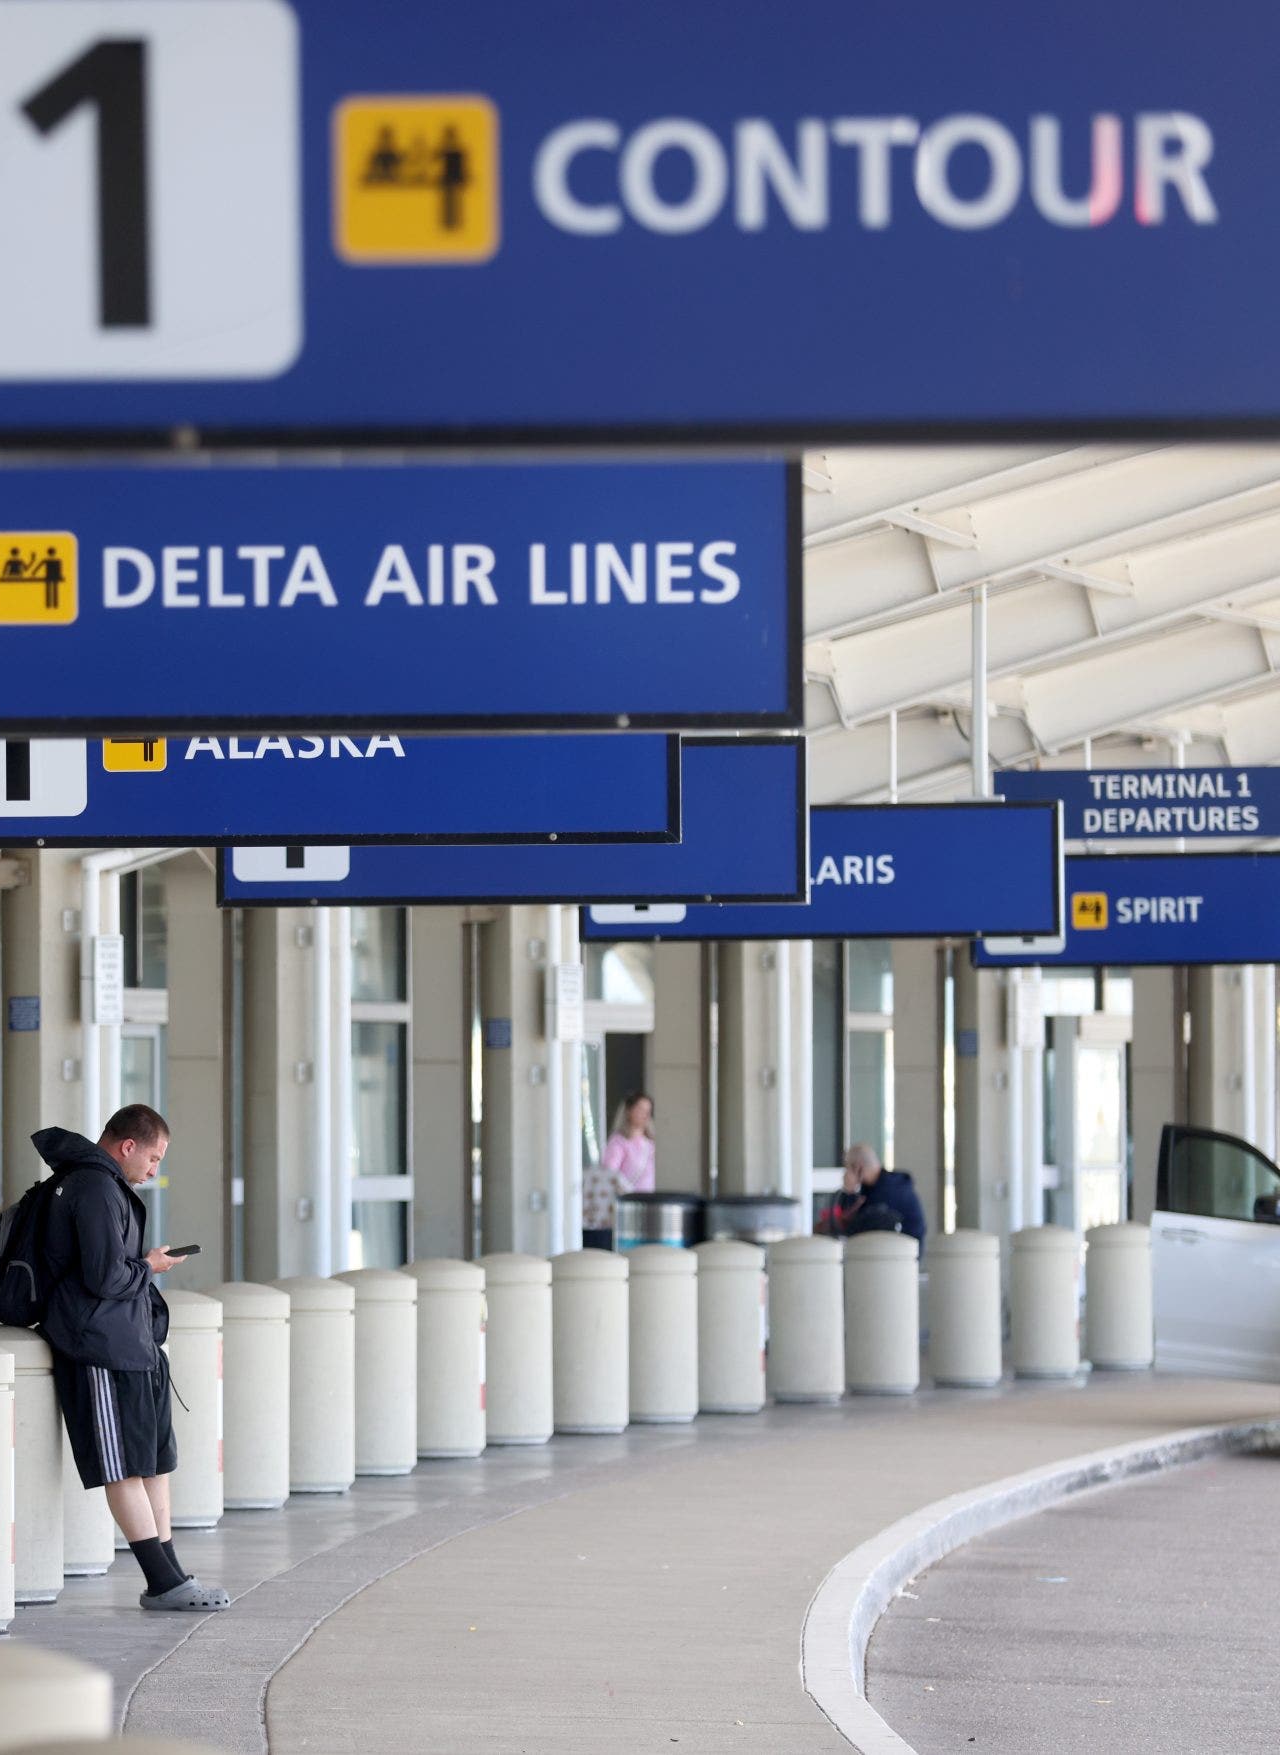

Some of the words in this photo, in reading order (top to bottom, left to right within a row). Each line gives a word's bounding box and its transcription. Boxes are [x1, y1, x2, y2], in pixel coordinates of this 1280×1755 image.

[18, 37, 152, 332] 1
[536, 113, 1218, 232] CONTOUR
[104, 546, 337, 608] DELTA
[366, 544, 497, 606] AIR
[530, 541, 741, 605] LINES
[185, 736, 406, 760] ALASKA
[1089, 774, 1232, 799] TERMINAL
[1237, 773, 1251, 797] 1
[1084, 806, 1259, 833] DEPARTURES
[810, 854, 895, 885] ARIS
[1116, 896, 1203, 923] SPIRIT
